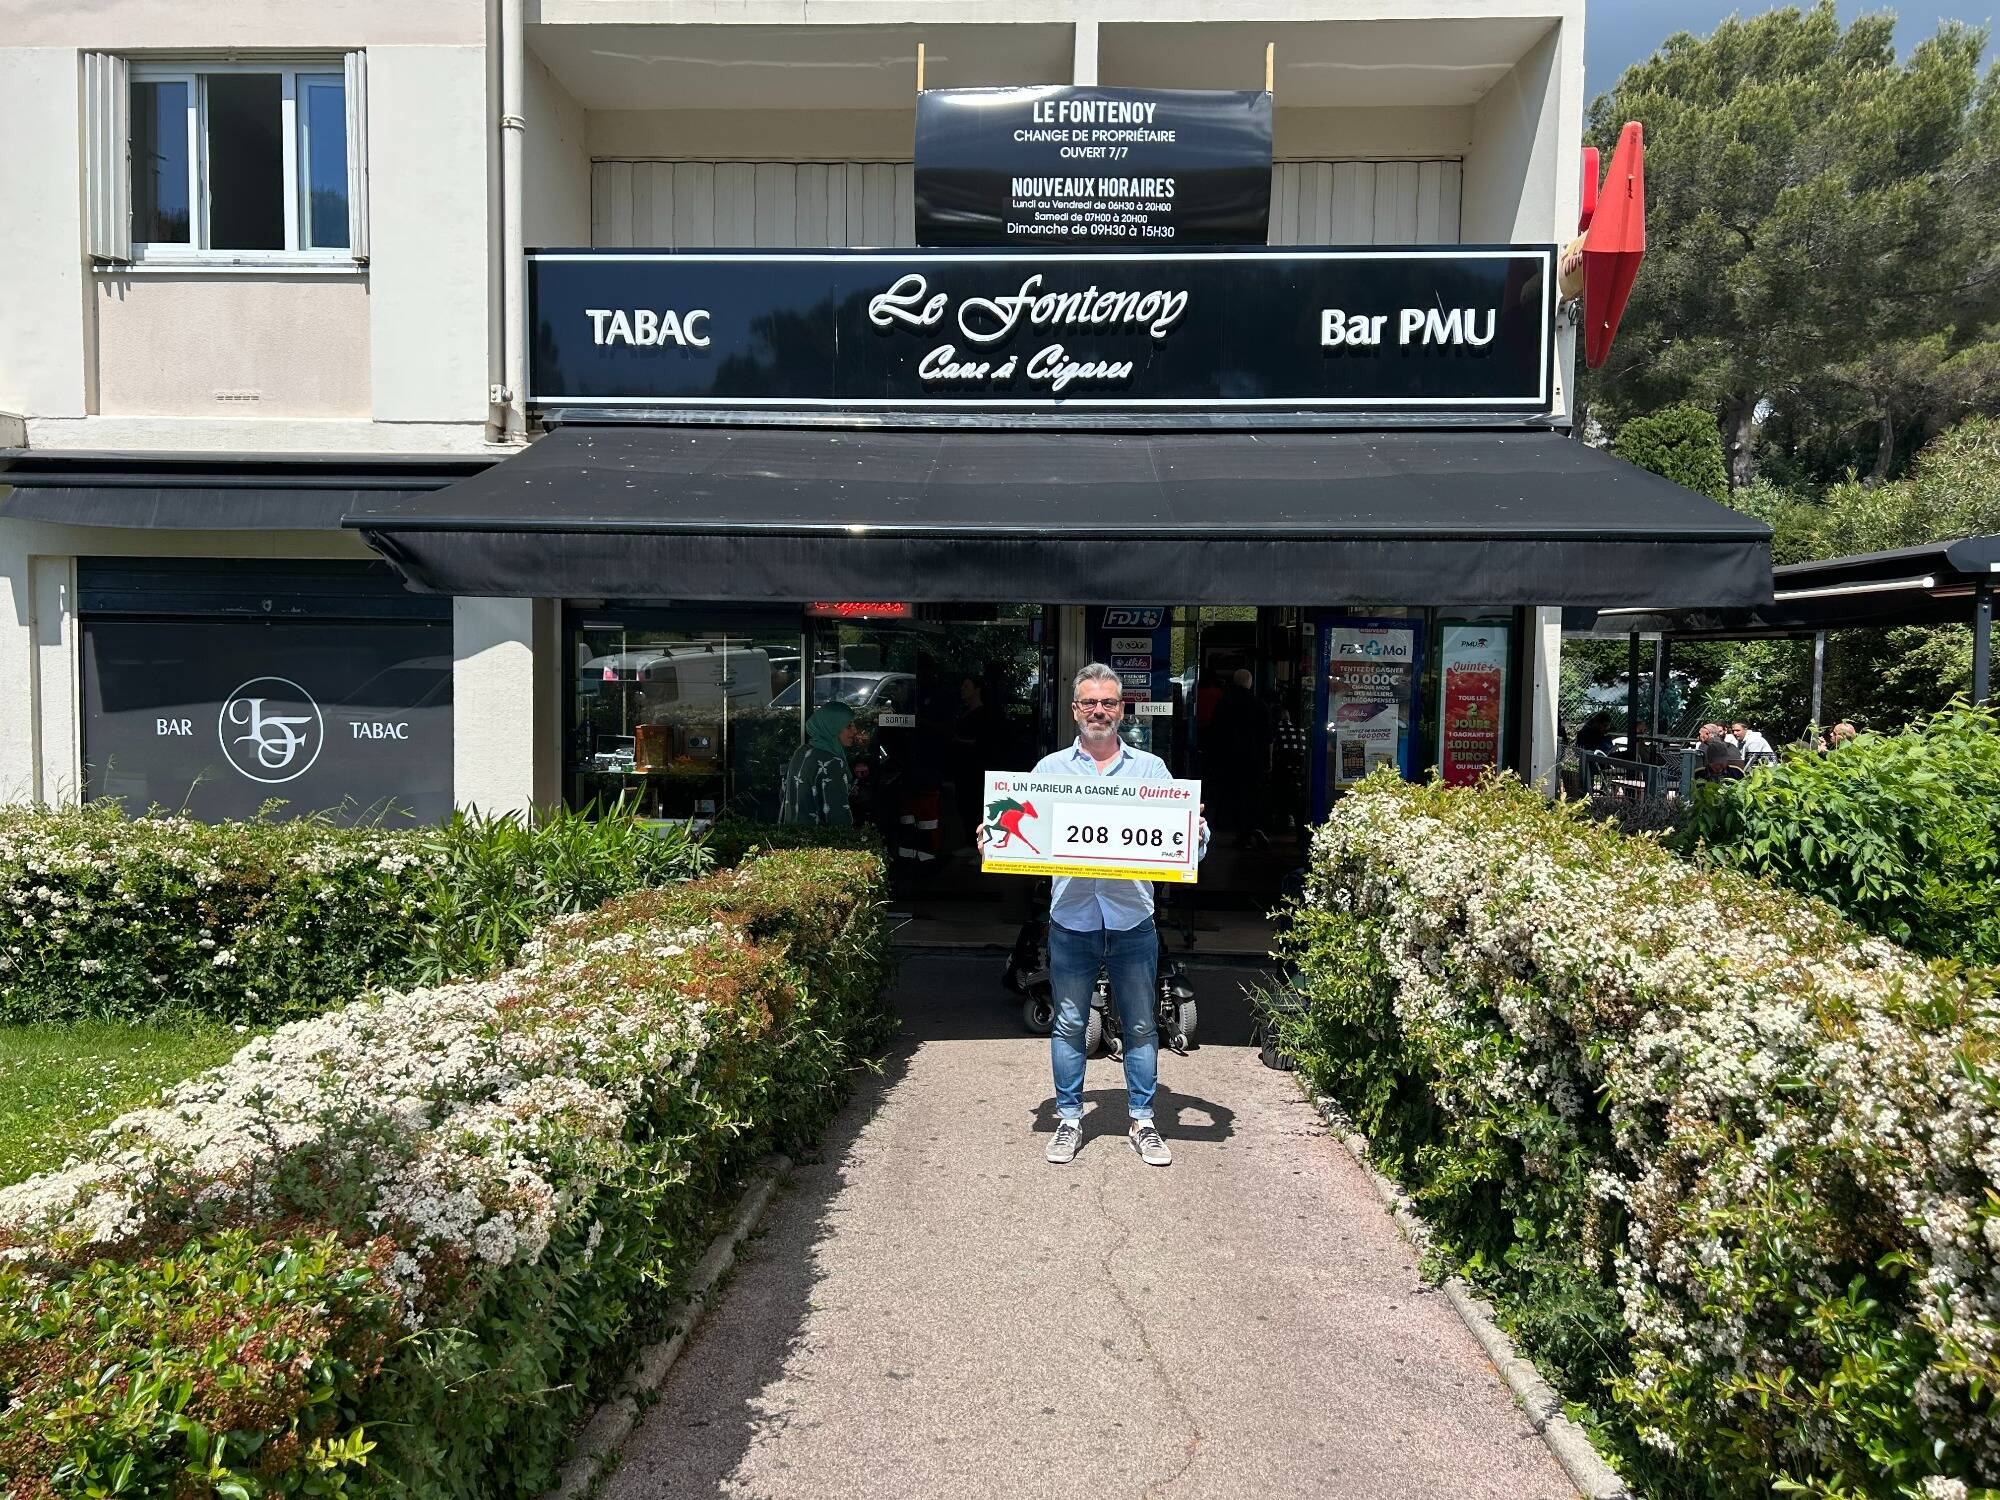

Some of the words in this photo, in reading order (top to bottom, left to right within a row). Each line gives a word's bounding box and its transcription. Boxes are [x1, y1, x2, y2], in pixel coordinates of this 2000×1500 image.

[1033, 101, 1055, 123] LE
[1059, 100, 1156, 123] FONTENOY
[1013, 129, 1071, 142] CHANGE
[1072, 130, 1090, 142] DE
[1091, 127, 1176, 143] PROPRIÉTAIRE
[1060, 146, 1107, 159] OUVERT
[1109, 147, 1128, 161] 7/7
[1011, 177, 1095, 198] NOUVEAUX
[1099, 177, 1175, 199] HORAIRES
[1012, 199, 1036, 209] Lundi
[1038, 201, 1050, 209] au
[1052, 200, 1092, 210] Vendredi
[1093, 201, 1107, 210] de
[1108, 202, 1134, 211] 06H30
[1136, 202, 1143, 211] à
[1144, 202, 1172, 212] 20H00
[1034, 212, 1068, 222] Samedi
[1070, 212, 1083, 222] de
[1085, 213, 1111, 223] 07H00
[1112, 213, 1120, 222] à
[1121, 213, 1148, 224] 20H00
[1007, 222, 1069, 235] Dimanche
[1071, 223, 1088, 235] de
[1090, 224, 1126, 236] 09H30
[1128, 225, 1138, 236] à
[1141, 226, 1175, 238] 15H30
[868, 273, 948, 326] Le
[957, 273, 1189, 342] Fontenoy
[585, 309, 711, 346] TABAC
[1321, 309, 1388, 346] Bar
[1399, 308, 1496, 346] PMU
[918, 344, 990, 379] Cave
[991, 355, 1018, 379] à
[1026, 343, 1133, 392] Cigares
[1108, 611, 1141, 625] FDJ
[1382, 645, 1407, 656] Moi
[1461, 640, 1478, 648] PMU
[1340, 666, 1364, 674] TENTEZ
[1364, 666, 1375, 674] DE
[1343, 674, 1361, 684] 10
[1122, 691, 1147, 701] amigo
[1141, 701, 1167, 713] ENTRÉE
[1466, 703, 1478, 716] 2
[156, 718, 193, 736] BAR
[885, 716, 909, 724] SORTIE
[1453, 719, 1491, 729] JOURS
[349, 722, 409, 740] TABAC
[1452, 752, 1490, 762] EUROS
[994, 781, 1011, 793] ICI,
[1012, 783, 1028, 792] UN
[1030, 784, 1073, 794] PARIEUR
[1074, 785, 1084, 794] A
[1084, 785, 1119, 796] GAGNÉ
[1121, 787, 1136, 796] AU
[1138, 785, 1191, 800] Quinté+
[1066, 825, 1109, 844] 208
[1121, 828, 1163, 846] 908
[1172, 831, 1184, 846] €
